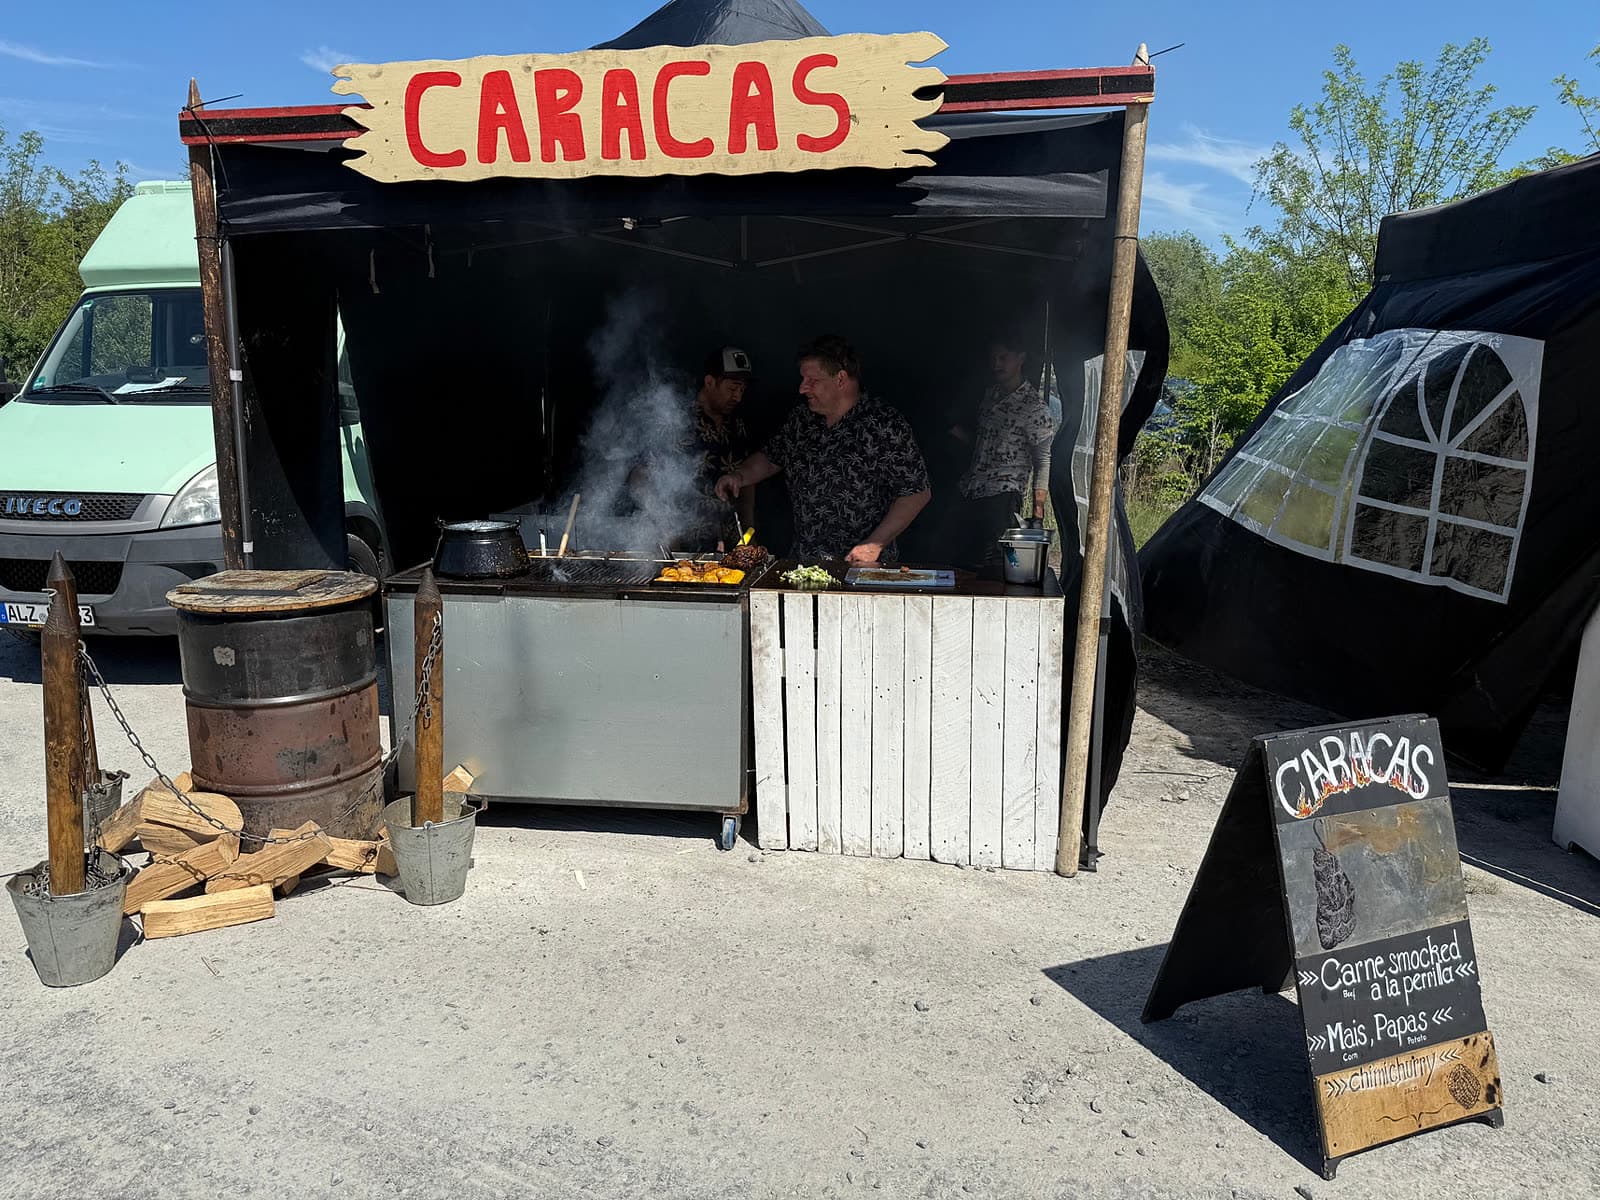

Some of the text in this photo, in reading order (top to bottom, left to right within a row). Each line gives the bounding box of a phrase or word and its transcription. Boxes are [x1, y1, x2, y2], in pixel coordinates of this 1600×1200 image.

[404, 53, 851, 168] CARACAS
[5, 497, 82, 516] IVECO
[8, 604, 39, 622] ALZ
[1275, 731, 1434, 820] CARACAS
[1320, 929, 1463, 991] Carne smocked
[1370, 961, 1456, 1006] a la perrilla
[1373, 1010, 1429, 1046] Papas
[1406, 1034, 1428, 1045] Potato
[1342, 1052, 1359, 1062] Corn
